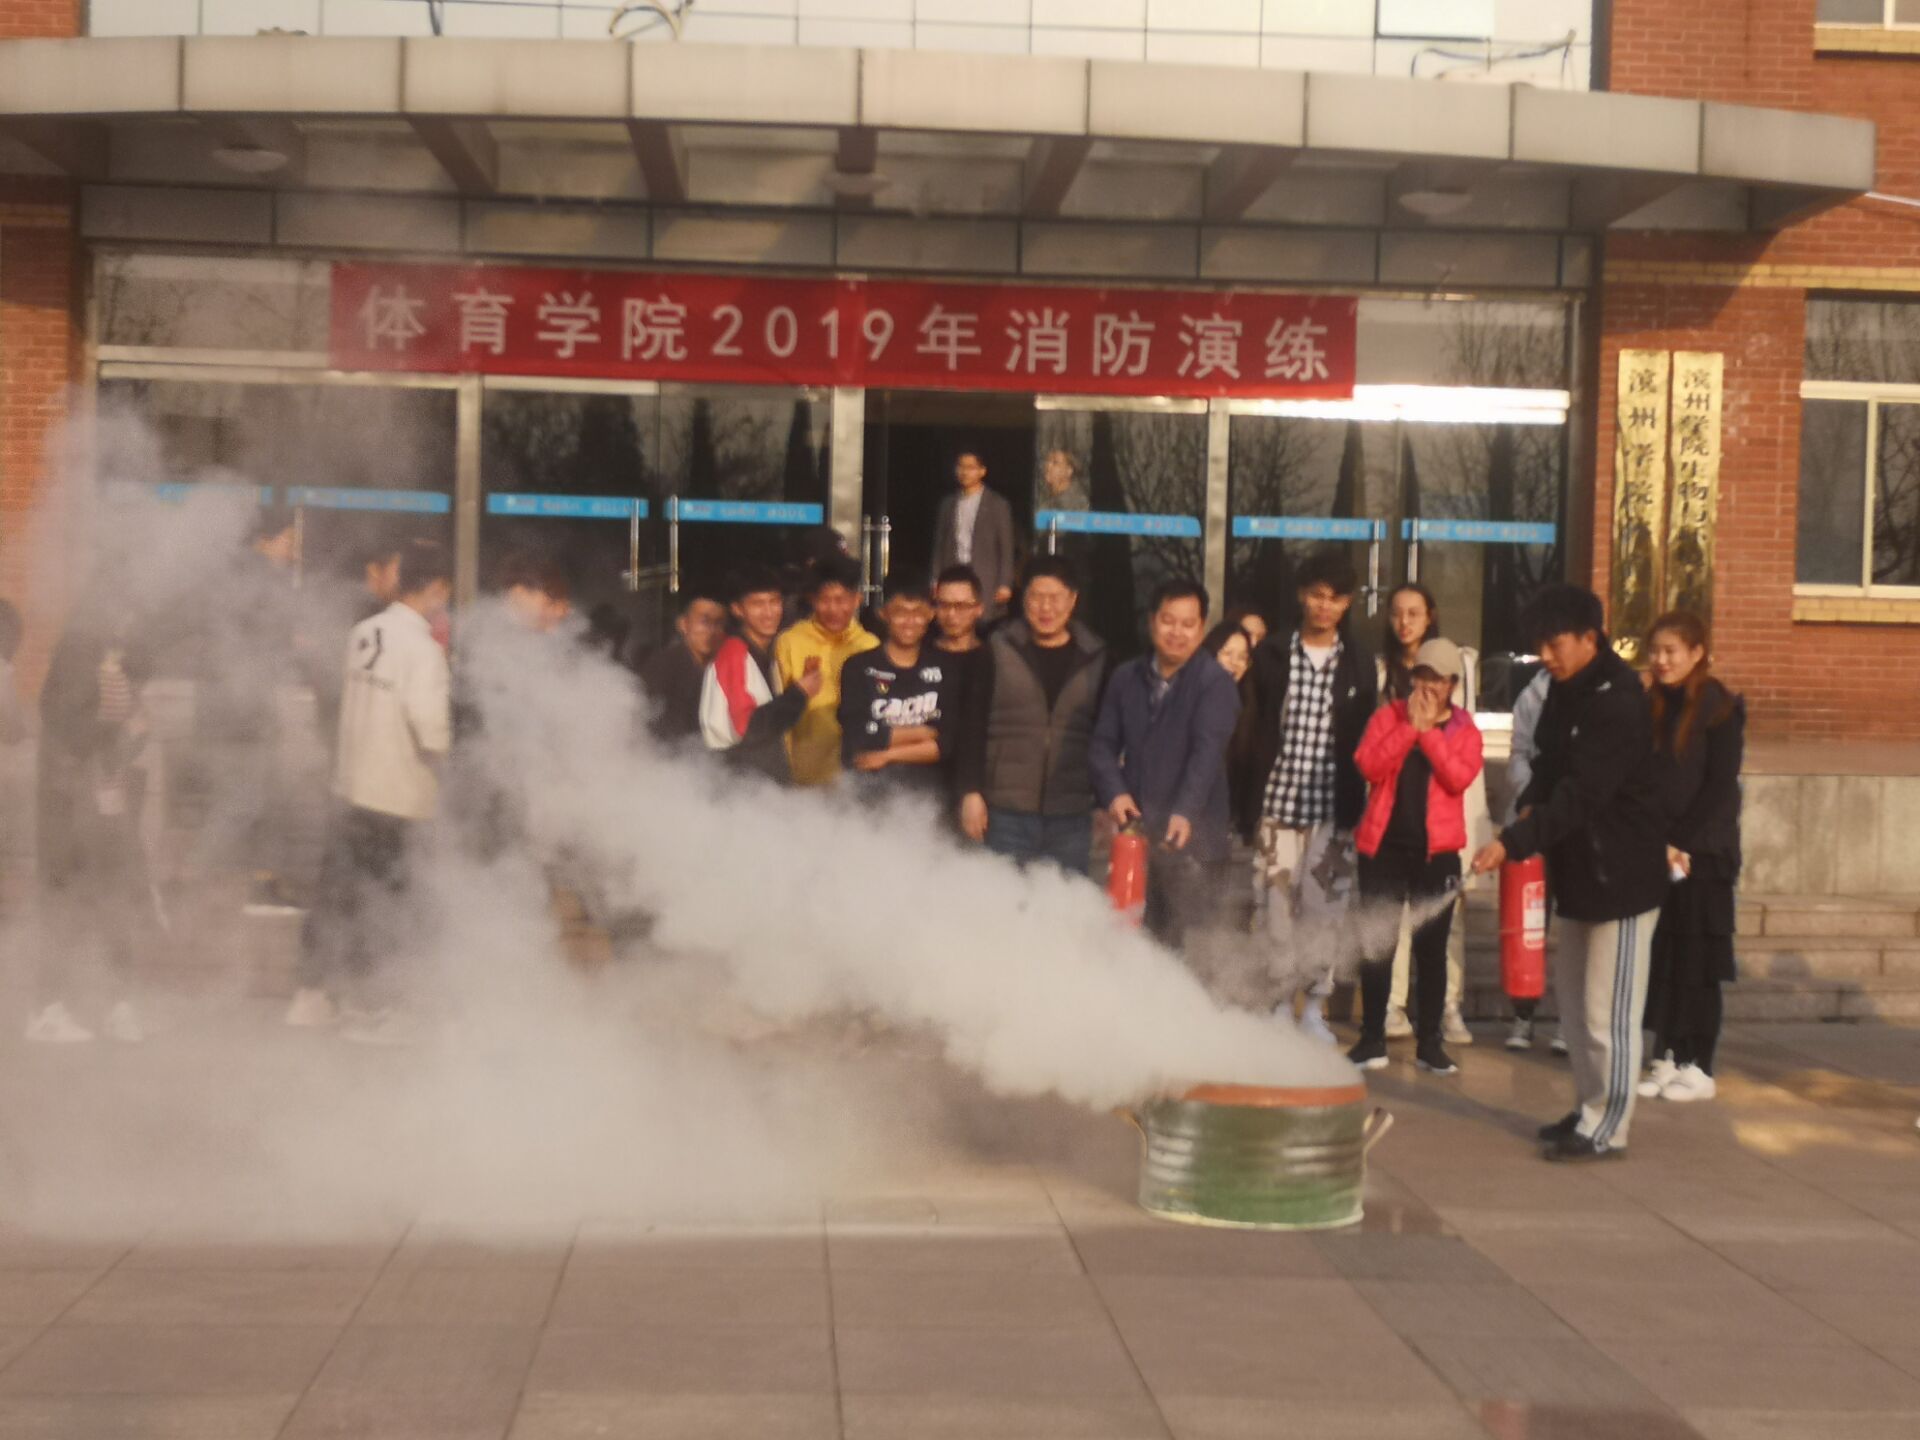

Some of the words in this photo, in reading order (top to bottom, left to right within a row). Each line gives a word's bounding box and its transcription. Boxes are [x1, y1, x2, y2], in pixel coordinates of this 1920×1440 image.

[359, 284, 1330, 380] 体育学院2019年消防演练
